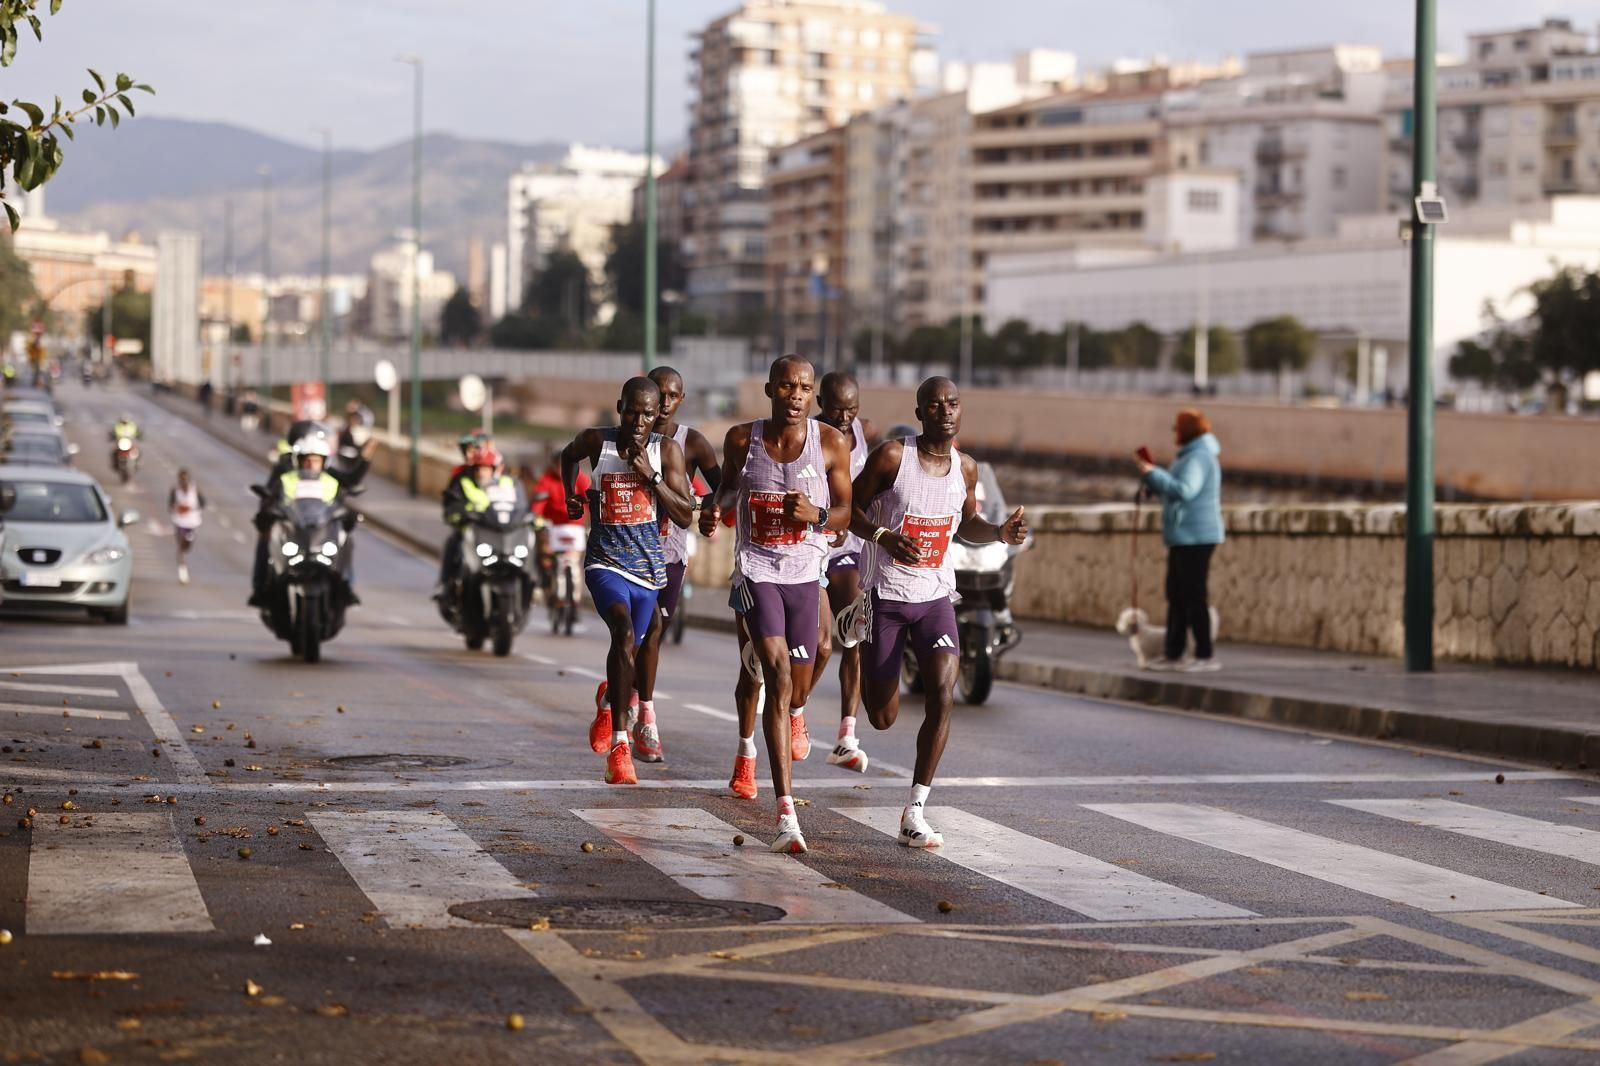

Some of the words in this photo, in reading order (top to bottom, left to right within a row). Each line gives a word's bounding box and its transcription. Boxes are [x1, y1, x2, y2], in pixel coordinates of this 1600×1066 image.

[766, 507, 785, 515] PACE
[919, 516, 951, 527] GENERALI
[919, 530, 940, 538] PACER
